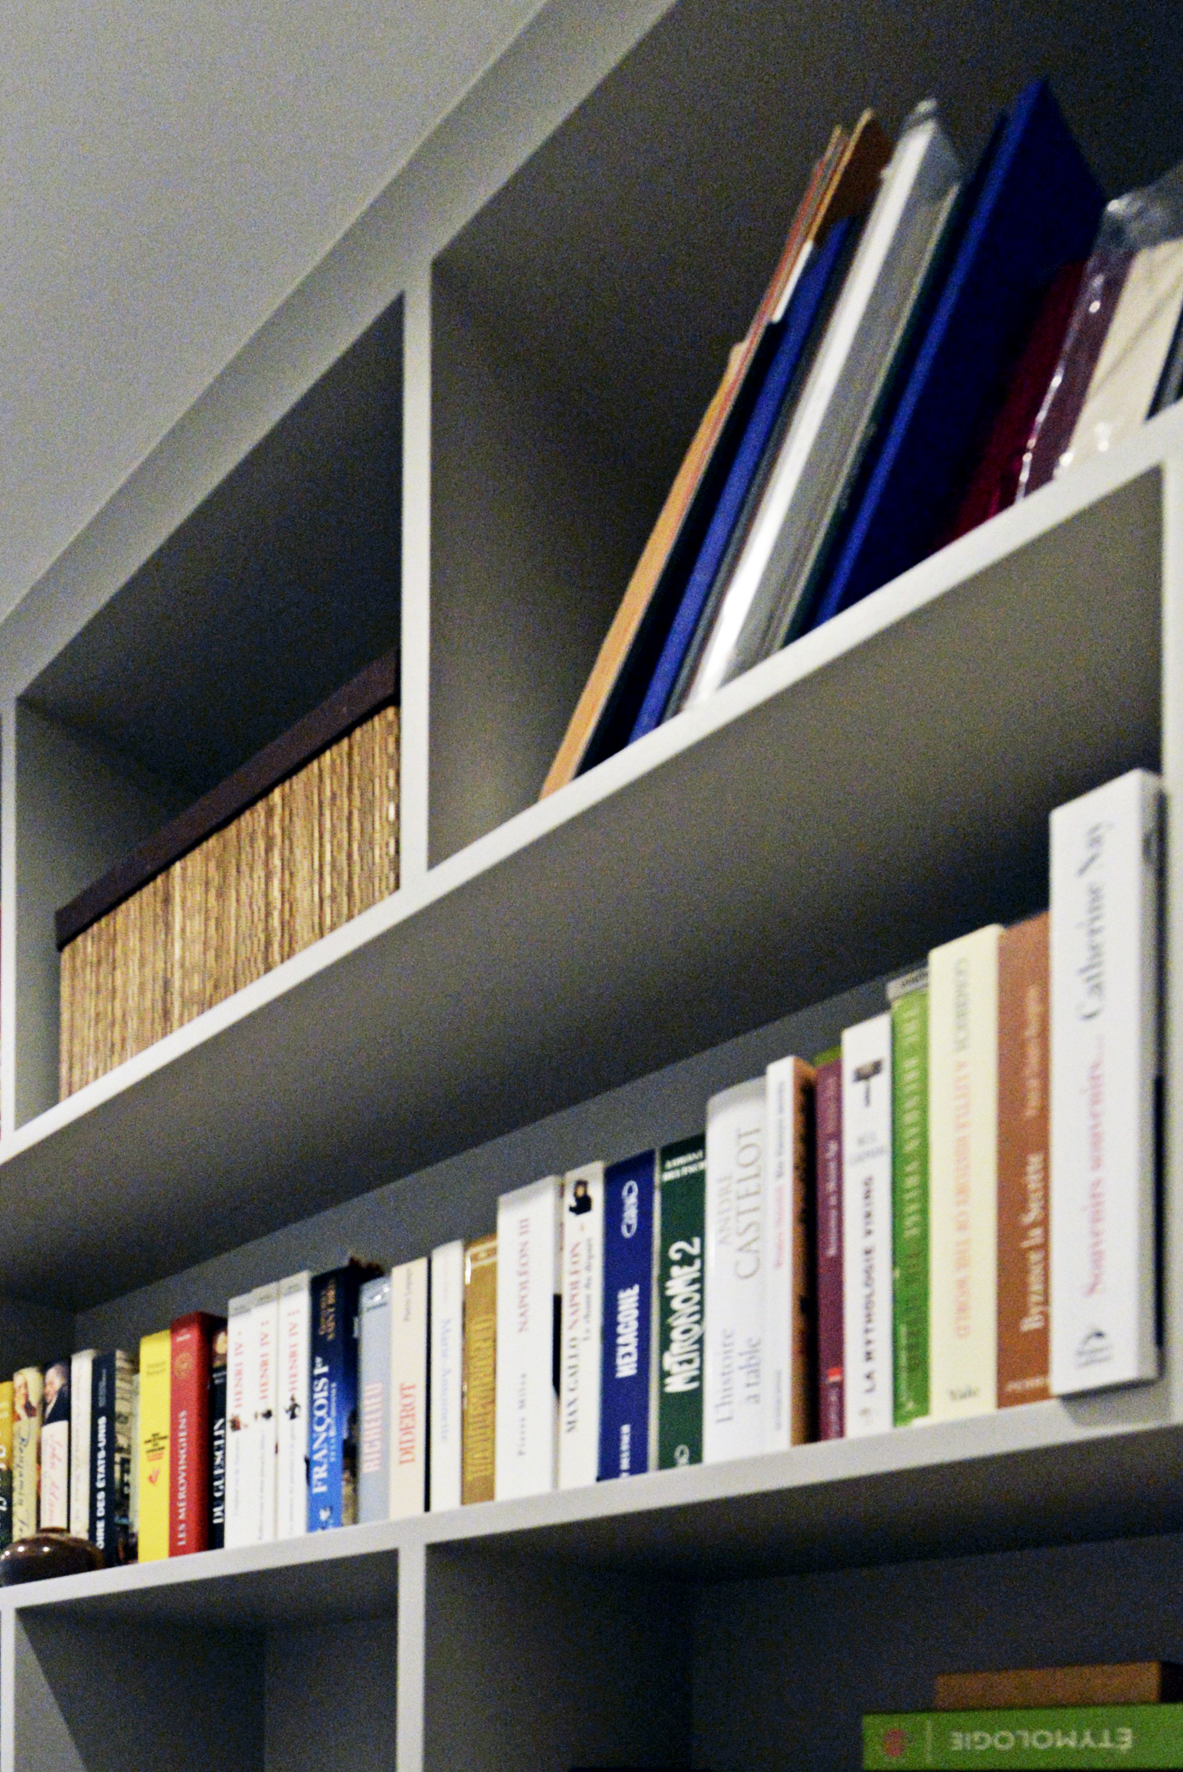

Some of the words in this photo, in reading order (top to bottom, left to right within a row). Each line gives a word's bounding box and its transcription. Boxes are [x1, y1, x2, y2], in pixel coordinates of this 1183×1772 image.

[1077, 822, 1113, 878] Nay
[1076, 882, 1108, 1021] Catherine
[517, 1218, 530, 1235] III
[735, 1126, 763, 1279] CASTELOT
[862, 1175, 875, 1238] VIKING
[669, 1236, 700, 1259] 2
[1022, 1228, 1045, 1247] la
[1077, 1178, 1106, 1296] Souvenirs
[514, 1240, 530, 1333] NAPOLÉON
[861, 1246, 876, 1363] MYTHOLOGIE
[1020, 1249, 1048, 1332] Byzance
[234, 1340, 244, 1356] IV
[260, 1331, 270, 1346] IV
[288, 1321, 299, 1337] IV
[615, 1284, 640, 1379] HEXAGONE
[234, 1362, 244, 1407] HENRI
[259, 1352, 270, 1400] HENRI
[288, 1342, 299, 1393] HENRI
[567, 1336, 579, 1392] GALLO
[715, 1328, 736, 1423] L'histoire
[738, 1336, 762, 1389] table
[862, 1370, 876, 1393] LA
[312, 1377, 332, 1495] FRANÇOIS
[363, 1382, 383, 1474] RICHELIEU
[398, 1383, 417, 1465] DIDEROT
[565, 1397, 578, 1433] MAX
[95, 1415, 107, 1487] ÉTATS-UNIS
[176, 1410, 188, 1519] MÉROVINGIENS
[212, 1417, 225, 1497] GUESCLIN
[97, 1491, 106, 1516] DES
[212, 1499, 224, 1524] DU
[178, 1523, 187, 1546] LES
[949, 1727, 1134, 1753] ÉTYMOLOGIE
